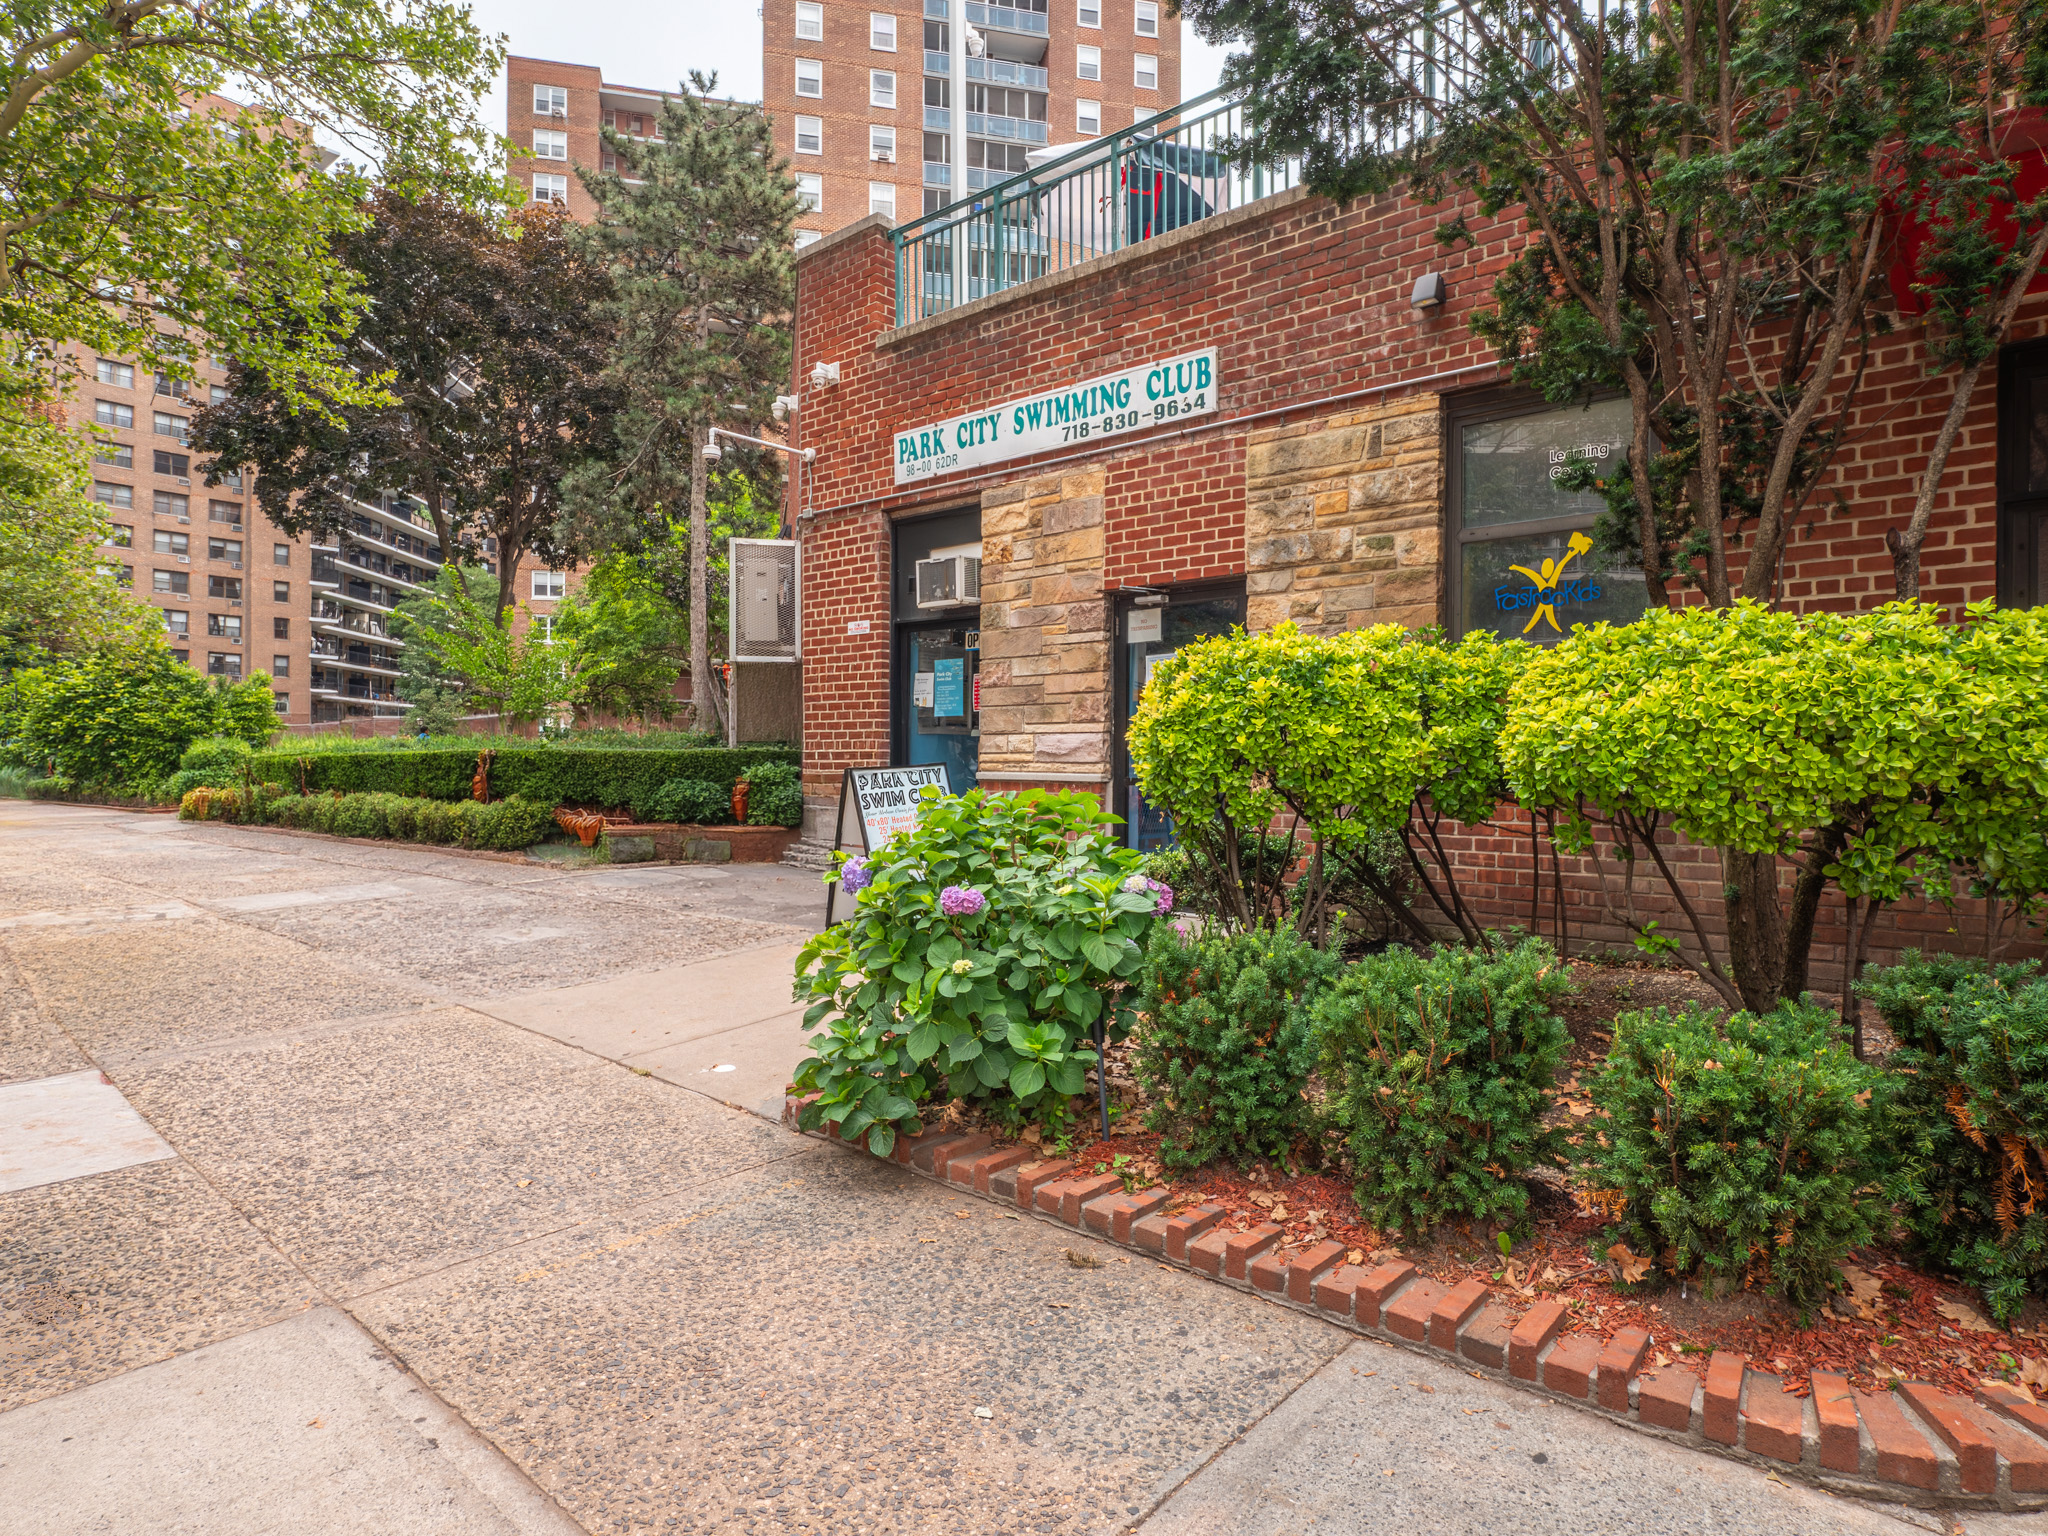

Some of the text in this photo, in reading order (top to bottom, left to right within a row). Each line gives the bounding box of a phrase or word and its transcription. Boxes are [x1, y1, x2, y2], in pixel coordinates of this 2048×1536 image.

[898, 356, 1212, 465] PARK CITY SWIMMING CLUB
[1550, 443, 1609, 463] Learning
[906, 453, 958, 476] 98-00 62DR
[861, 790, 906, 810] SWIM
